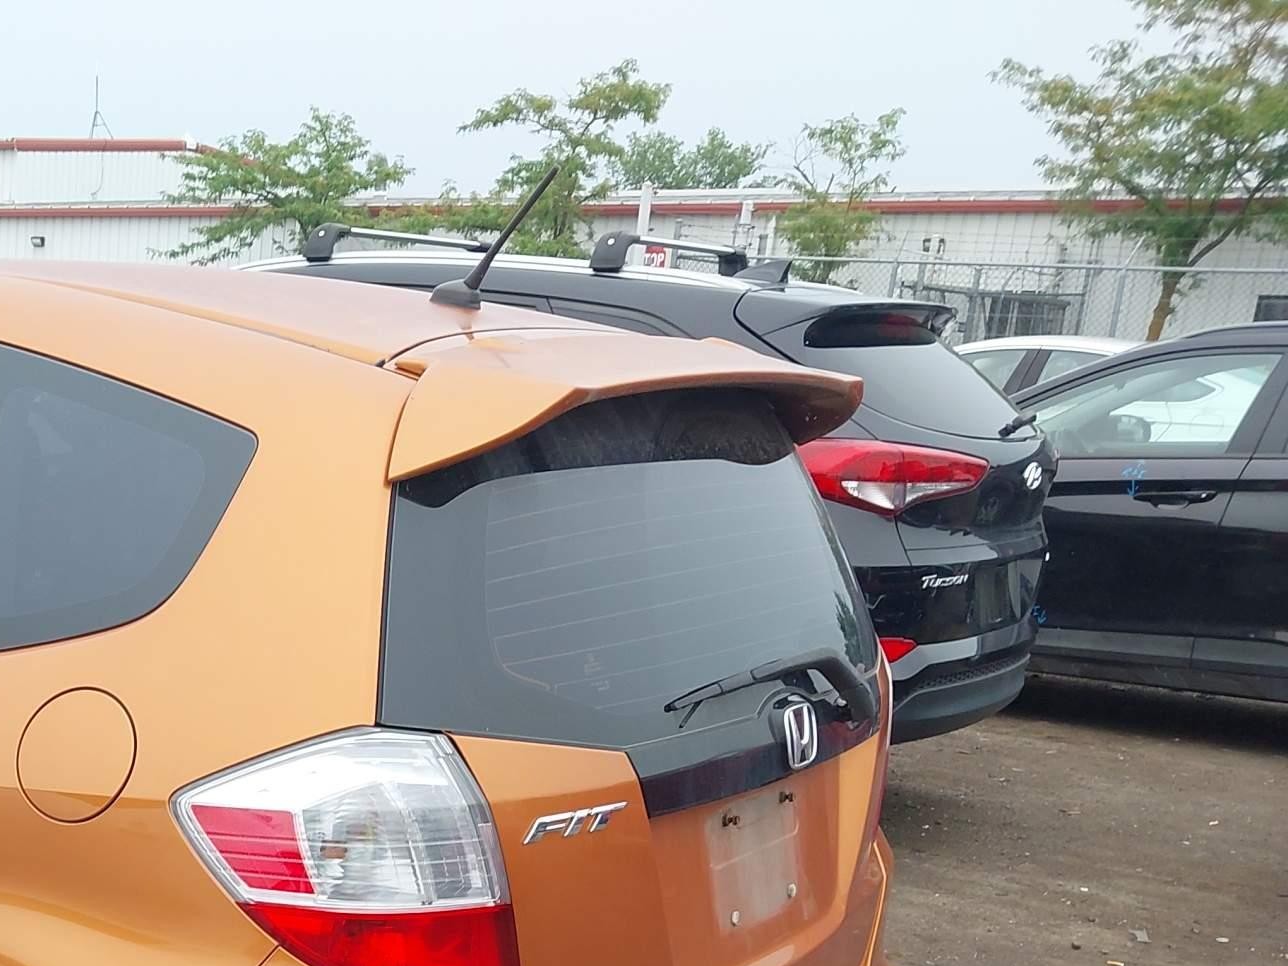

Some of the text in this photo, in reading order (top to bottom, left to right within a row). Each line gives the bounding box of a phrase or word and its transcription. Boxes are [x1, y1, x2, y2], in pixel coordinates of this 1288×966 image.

[644, 252, 665, 268] TOP
[921, 574, 969, 590] Tucson
[522, 801, 628, 846] FIT
